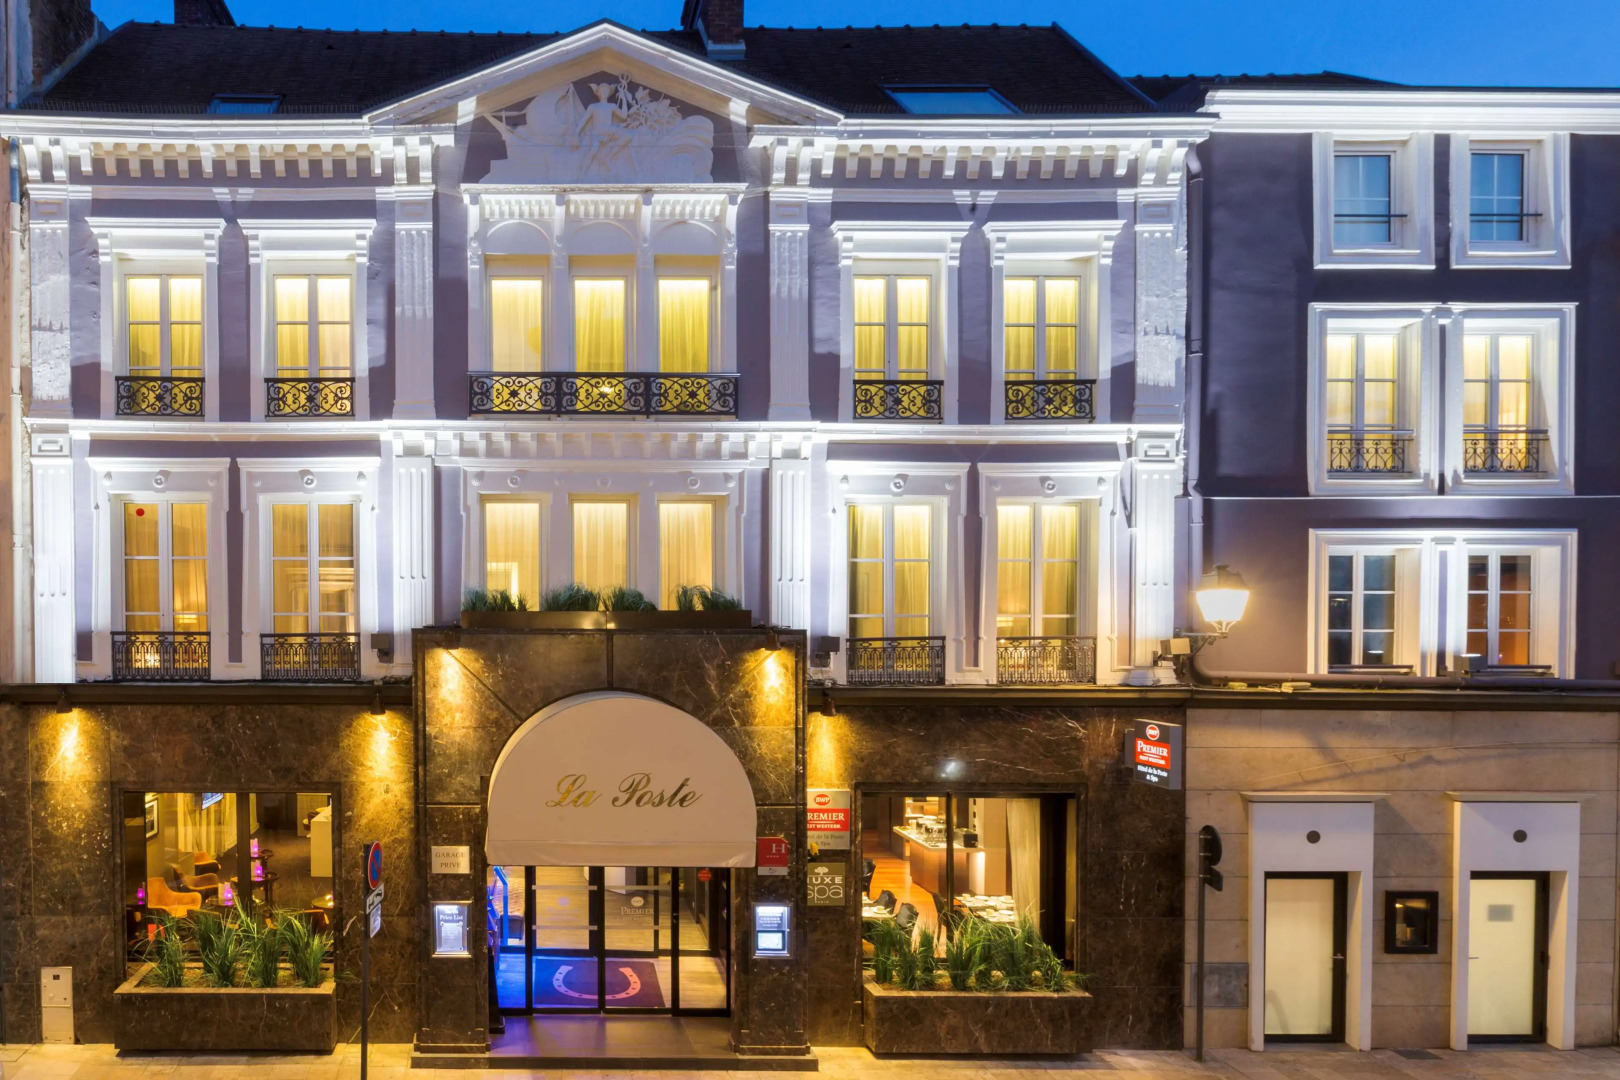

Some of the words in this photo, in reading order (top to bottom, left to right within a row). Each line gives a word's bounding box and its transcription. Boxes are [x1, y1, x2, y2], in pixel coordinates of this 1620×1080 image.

[1137, 741, 1168, 757] PREMIER
[545, 774, 603, 808] La
[611, 772, 704, 808] Poste
[807, 813, 845, 821] REMIER
[772, 844, 785, 853] H
[620, 906, 654, 915] PREMIER
